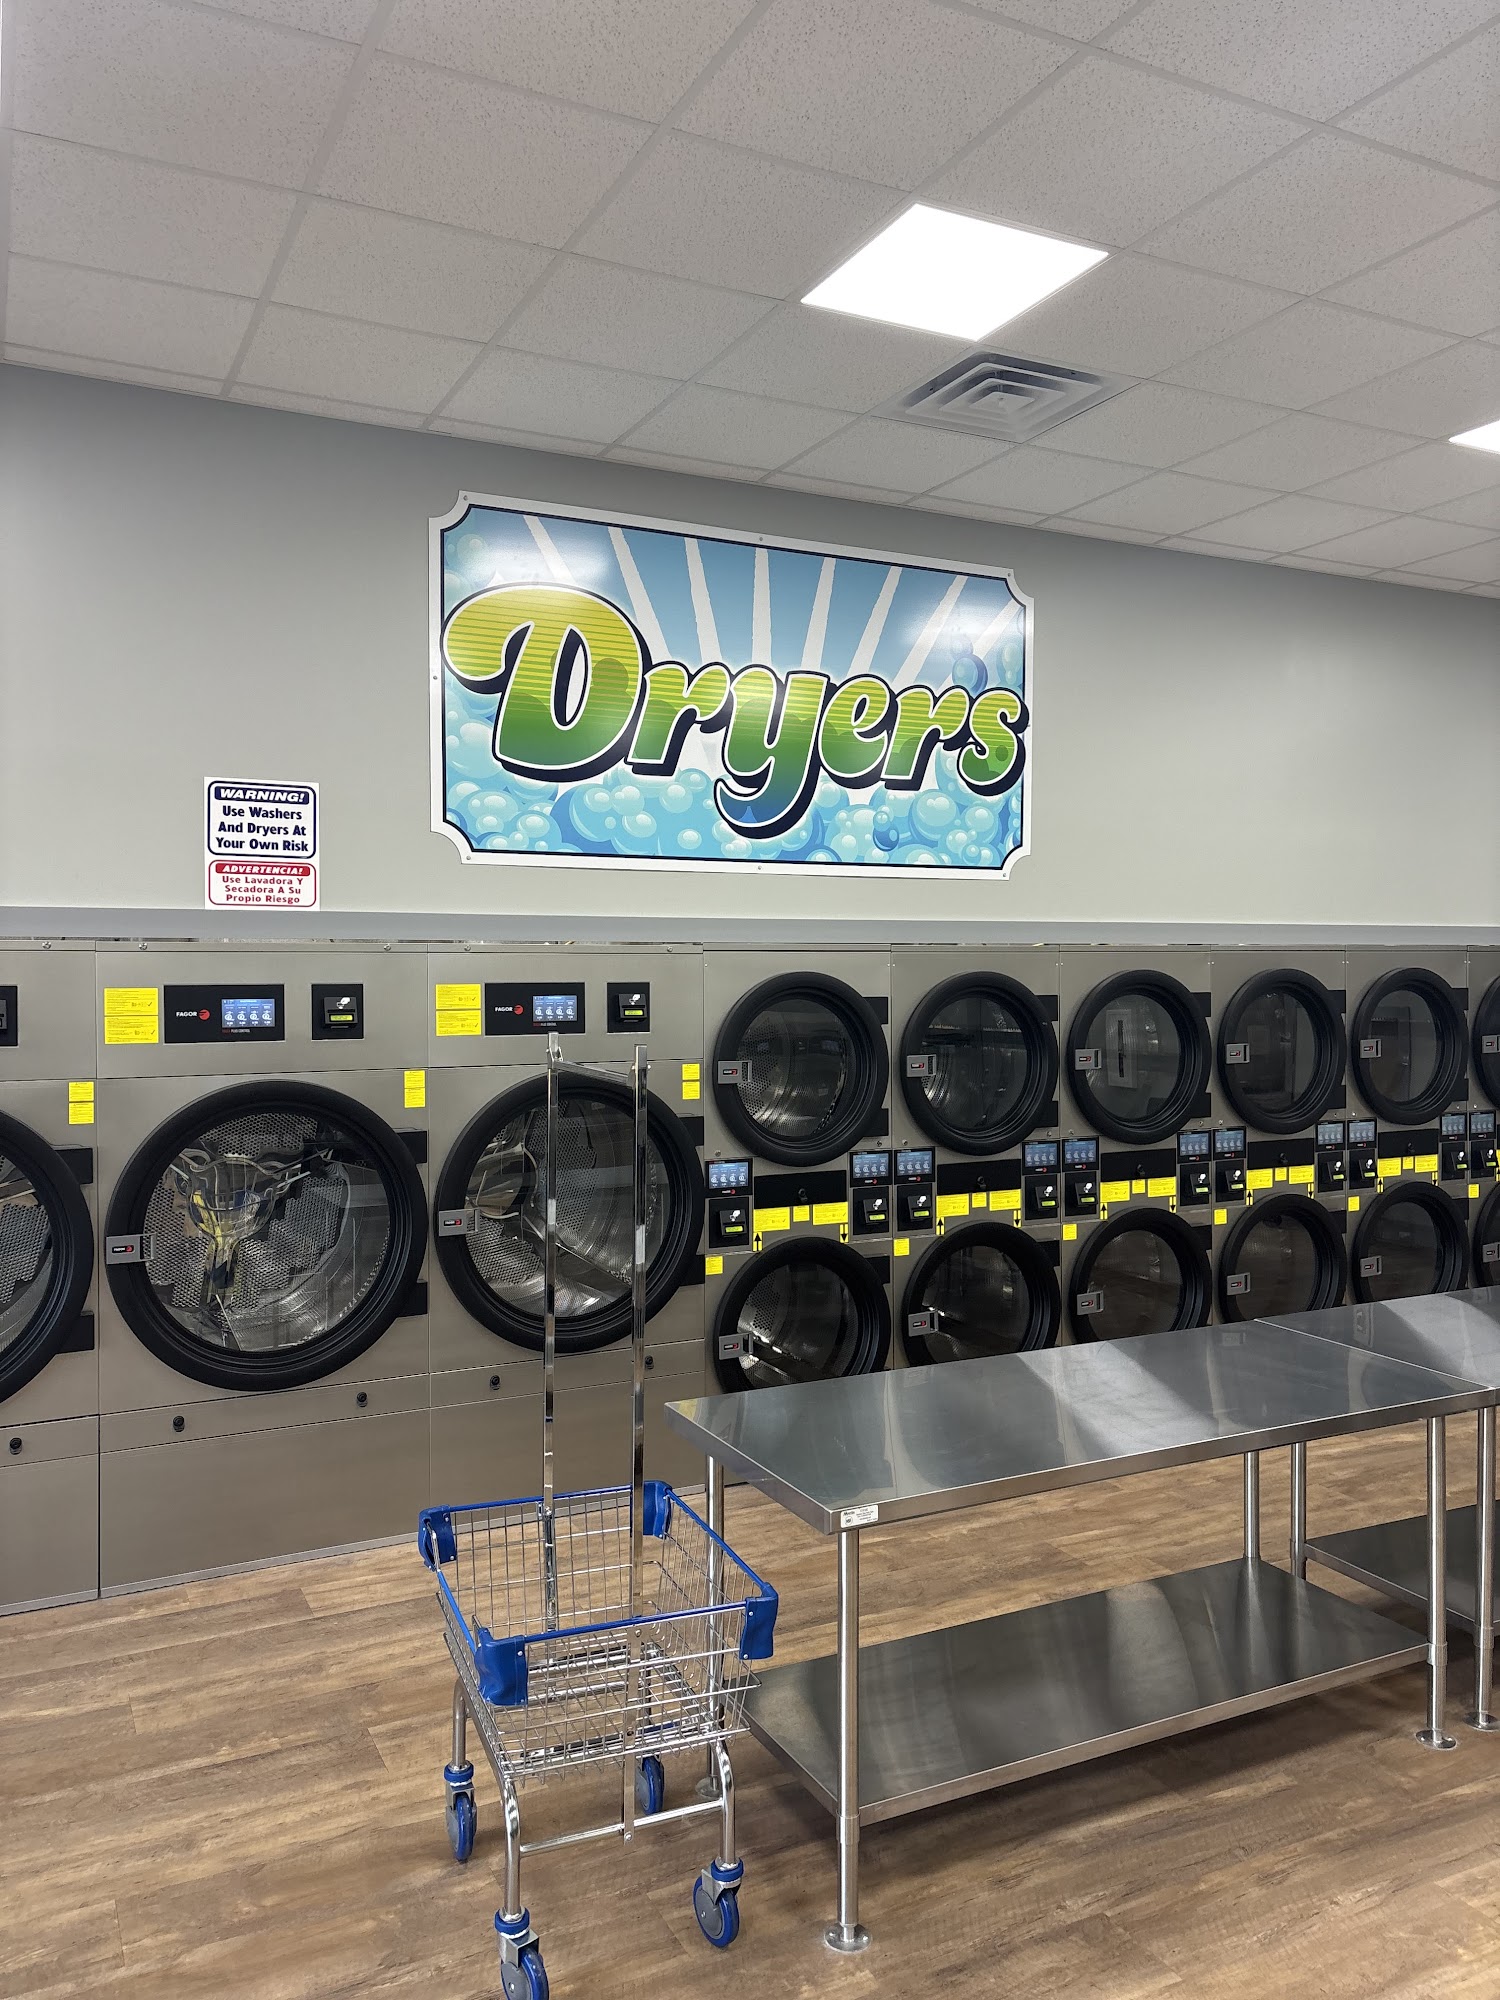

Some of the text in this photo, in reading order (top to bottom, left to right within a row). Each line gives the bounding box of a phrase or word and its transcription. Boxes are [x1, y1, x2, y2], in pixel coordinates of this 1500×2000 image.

[441, 582, 1030, 839] Dryers
[219, 788, 305, 803] WARNING!
[222, 805, 302, 820] Use Washers
[218, 821, 307, 836] And Dryers At
[215, 837, 309, 852] Your Own Risk
[222, 865, 303, 875] ADVERTENCIA!
[222, 875, 304, 885] Use Lavadora Y
[224, 884, 301, 894] Secadora A Su
[226, 894, 300, 904] Propio Riesgo
